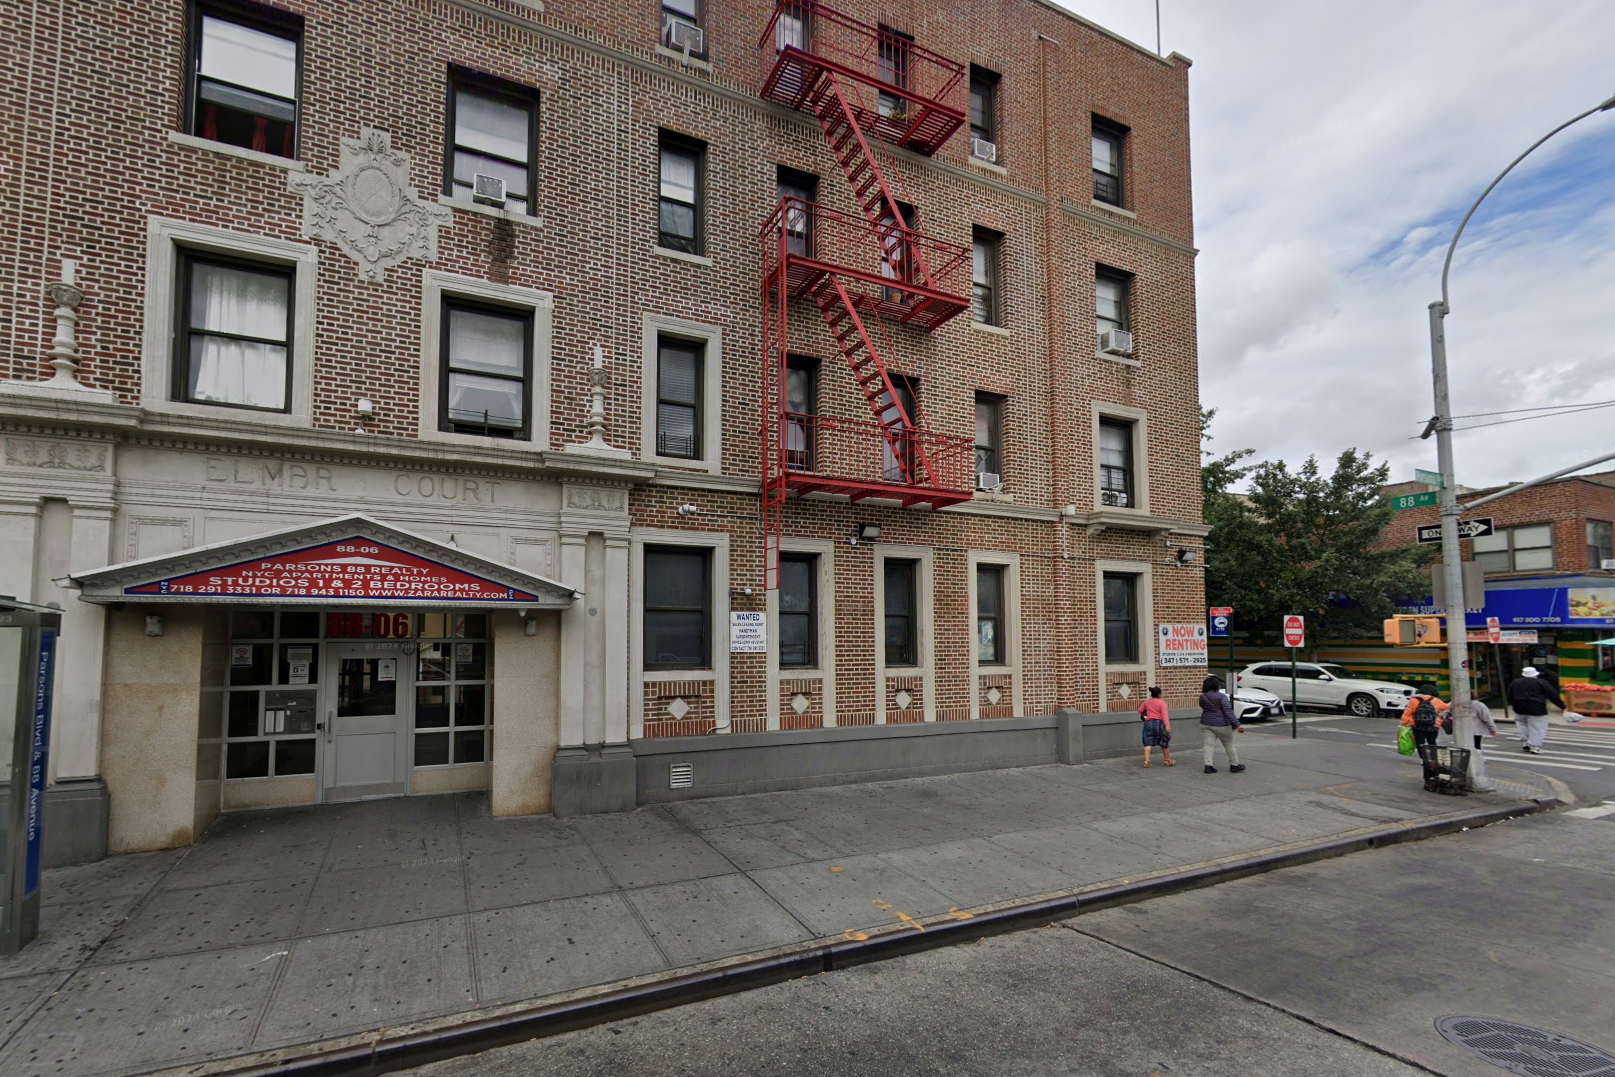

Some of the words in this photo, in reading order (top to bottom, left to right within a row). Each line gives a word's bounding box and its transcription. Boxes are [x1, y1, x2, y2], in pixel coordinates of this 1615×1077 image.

[205, 457, 337, 492] ELMAR
[394, 472, 504, 504] COURT
[1400, 496, 1415, 508] 88
[1427, 529, 1442, 538] ON
[1458, 524, 1480, 534] WAY
[336, 545, 379, 554] 88-06
[261, 562, 342, 573] PARSONS
[370, 566, 430, 575] REALTY
[280, 571, 382, 580] APARTMENTS
[400, 575, 447, 583] HOMES
[160, 581, 168, 594] NYC
[209, 577, 310, 587] STUDIOS
[316, 579, 324, 587] 1
[331, 580, 344, 588] &
[351, 580, 363, 588] 2
[369, 581, 481, 591] BEDROOMS
[171, 585, 193, 593] 718
[198, 585, 222, 593] 291
[226, 586, 256, 594] 3331
[261, 587, 281, 595] OR
[311, 588, 334, 596] 943
[368, 589, 508, 599] WWW.ZARAREALTY.COM
[736, 613, 760, 621] WANTED
[327, 612, 409, 639] 88-06
[1172, 625, 1195, 638] NOW
[1165, 638, 1206, 651] RENTING
[36, 651, 49, 710] Parsons
[34, 714, 45, 747] Blvd
[33, 751, 42, 760] &
[31, 765, 41, 783] 88
[28, 788, 40, 841] Avenue
